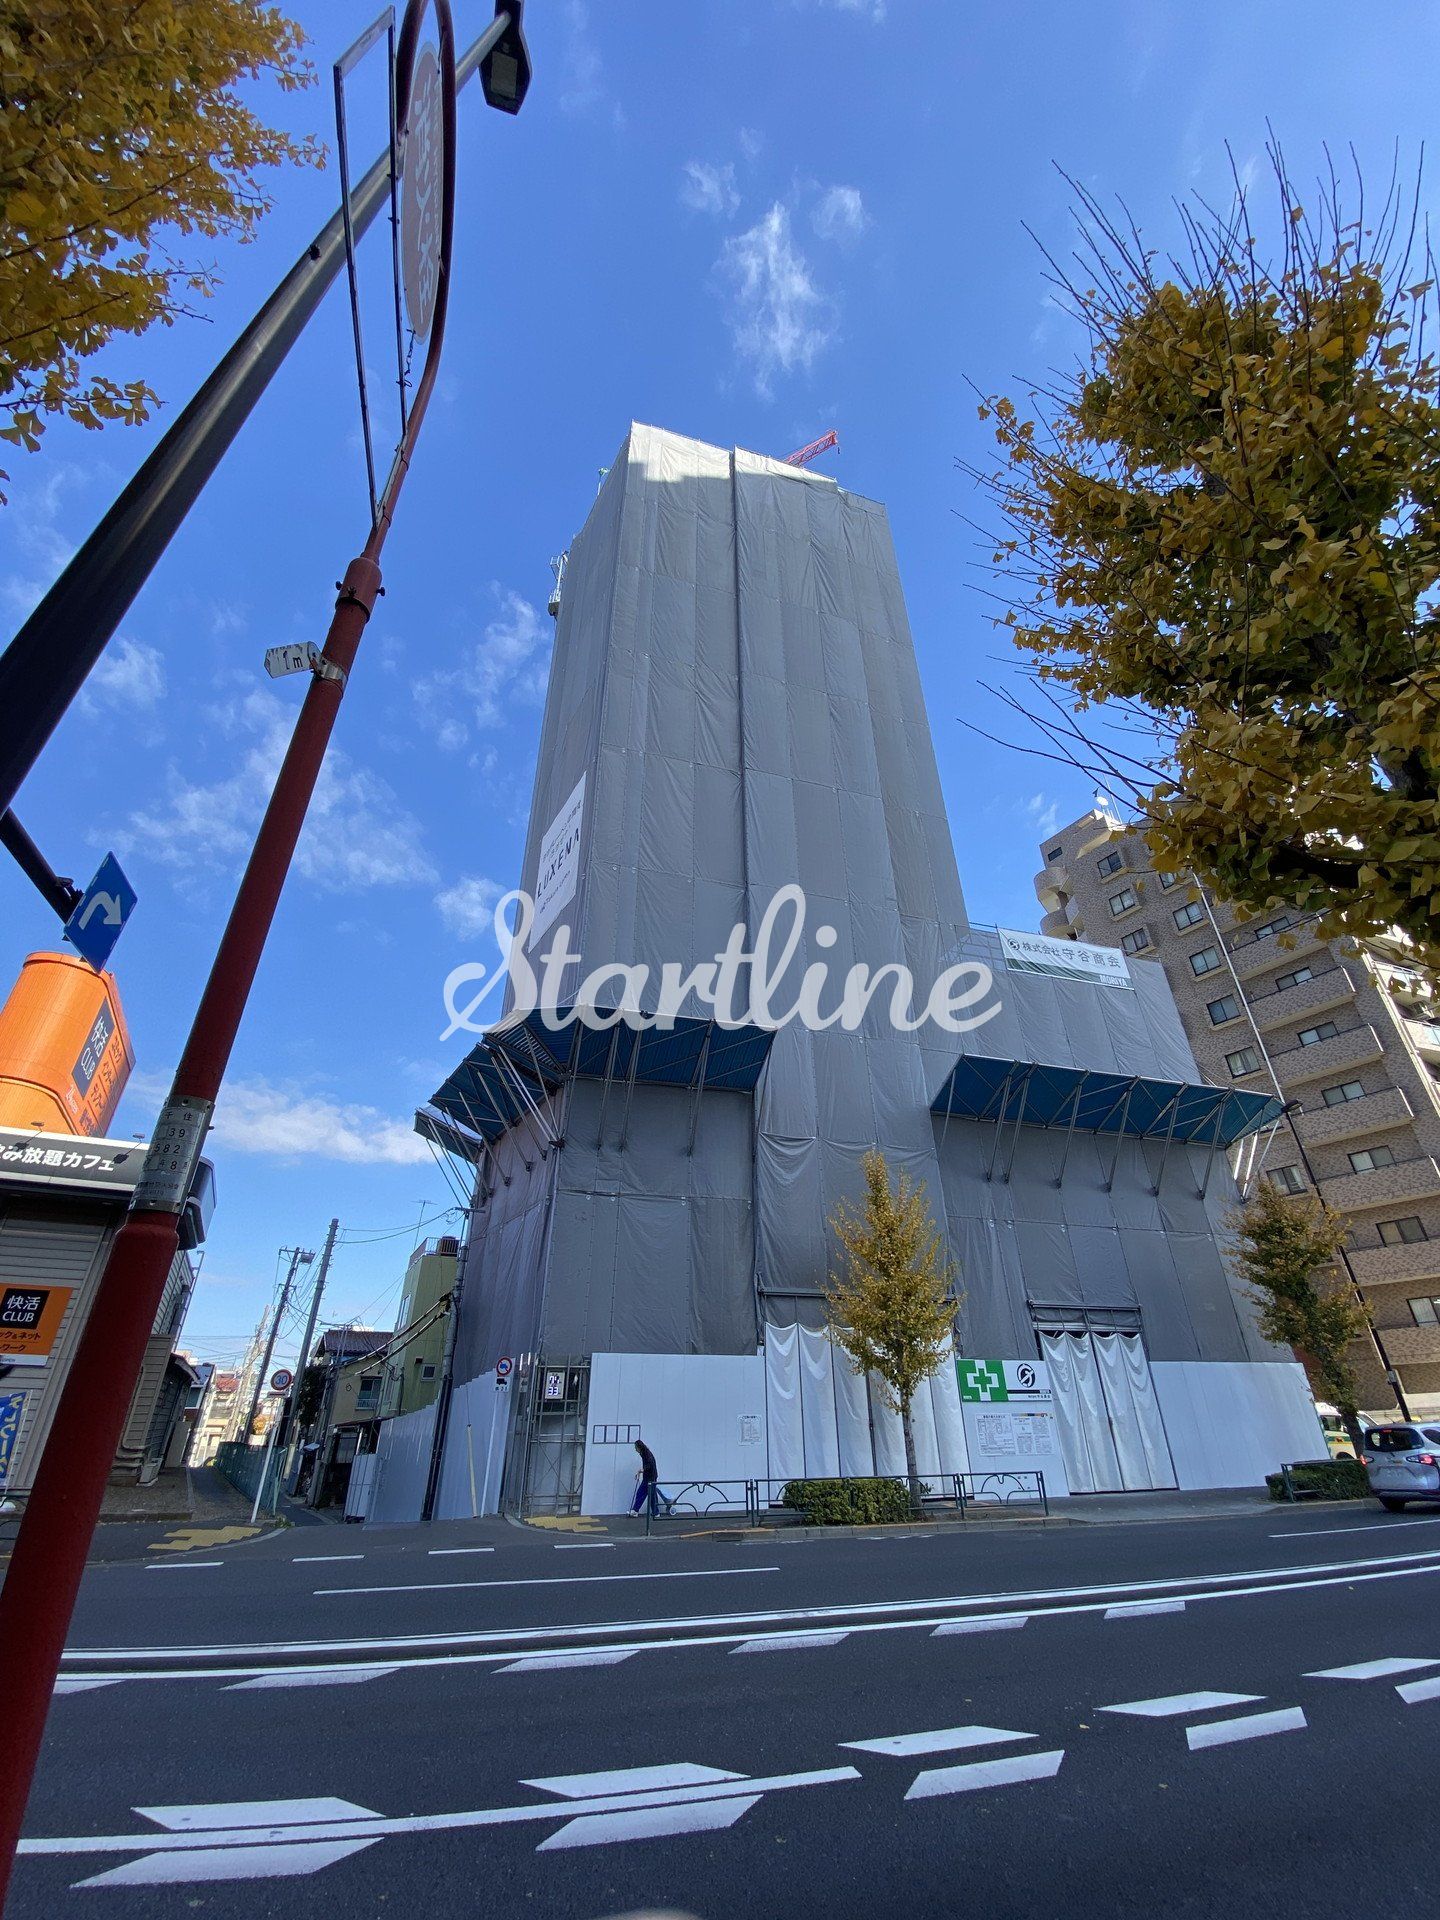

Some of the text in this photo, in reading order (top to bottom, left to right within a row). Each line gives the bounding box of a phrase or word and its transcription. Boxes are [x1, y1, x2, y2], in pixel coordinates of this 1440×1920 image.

[414, 73, 434, 325] 消火栓
[1022, 941, 1121, 968] 株式会社守谷商会
[90, 1016, 109, 1058] 快活
[80, 1047, 96, 1080] CLUB
[168, 1127, 186, 1138] 39
[0, 1143, 115, 1172] み放題カフェ
[7, 1295, 41, 1311] 快活
[2, 1311, 35, 1322] CLUB
[0, 1343, 26, 1352] ワーク
[275, 1375, 288, 1385] 30
